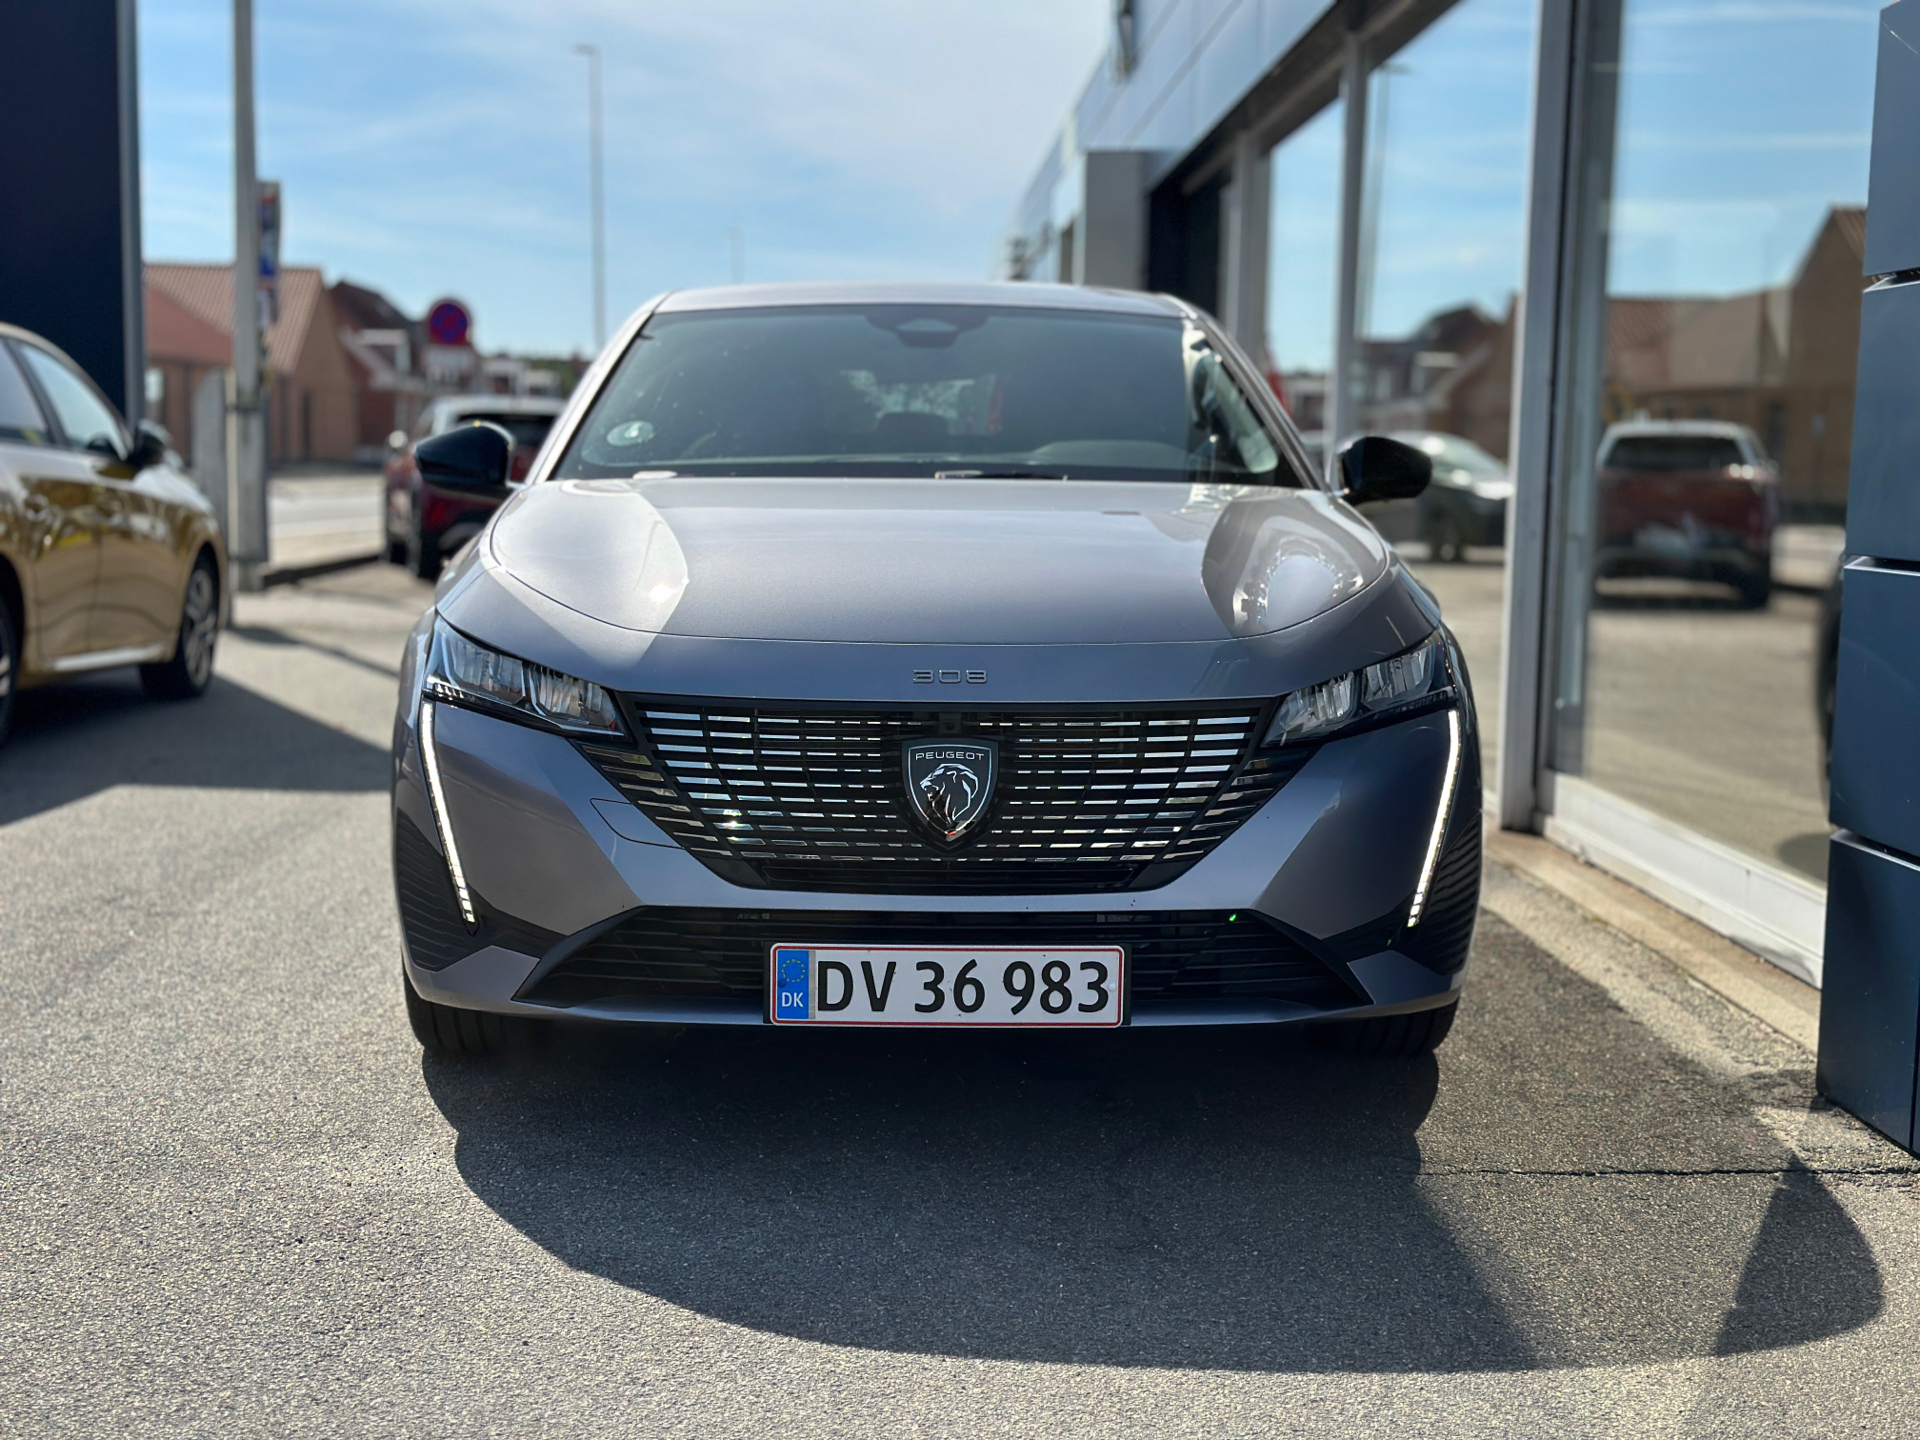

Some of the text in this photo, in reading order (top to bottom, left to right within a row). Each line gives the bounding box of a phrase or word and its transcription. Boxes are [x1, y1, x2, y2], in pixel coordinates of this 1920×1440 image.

[913, 669, 987, 684] 308
[915, 751, 985, 760] PEUGEOT
[817, 959, 1109, 1015] DV 36 983
[781, 992, 804, 1008] DK
